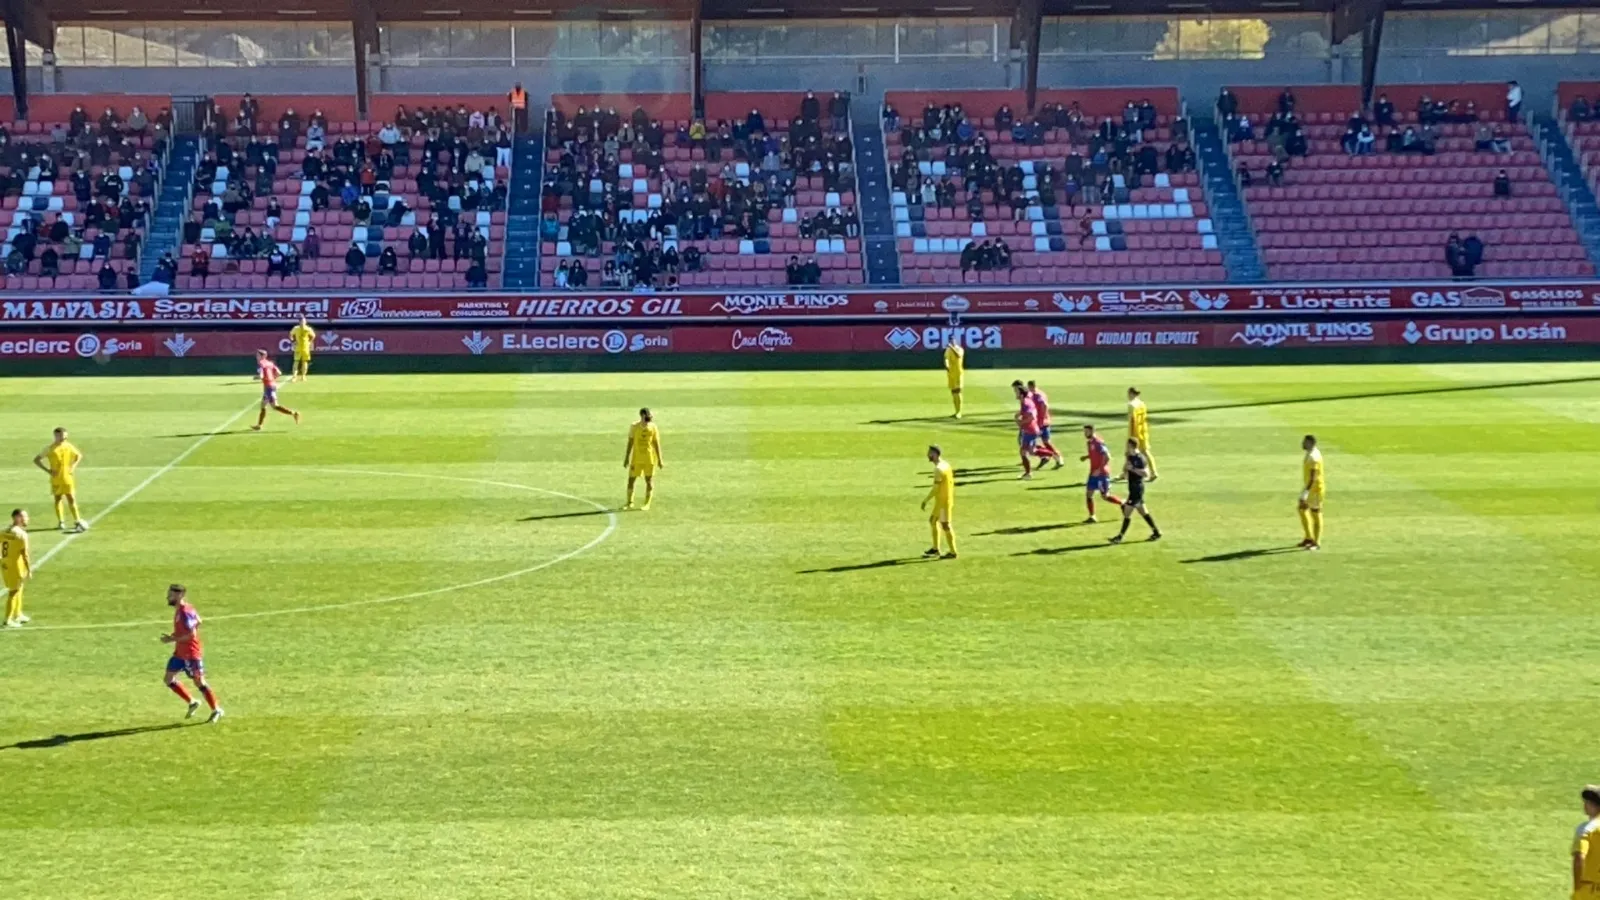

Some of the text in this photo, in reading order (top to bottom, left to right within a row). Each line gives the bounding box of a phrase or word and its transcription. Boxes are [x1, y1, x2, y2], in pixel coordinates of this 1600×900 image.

[724, 294, 848, 306] MONTE PINOS
[1098, 291, 1184, 303] ELKA
[1249, 295, 1391, 308] J. Llorente
[1411, 291, 1461, 307] GAS
[3, 302, 145, 319] MALVASIA
[154, 300, 329, 313] SoriaNatural
[517, 299, 683, 316] HIERROS GIL
[1096, 332, 1133, 345] CIUDAD
[1134, 332, 1153, 345] DEL
[1155, 331, 1199, 345] DEPORTE
[1245, 323, 1373, 337] MONTE PINOS
[1425, 323, 1566, 343] Grupo Losán
[102, 338, 142, 355] Soria
[341, 338, 384, 351] Soria
[503, 334, 599, 349] E.Leclerc
[629, 334, 669, 351] Soria
[732, 329, 757, 350] Casa
[2, 541, 8, 558] 8
